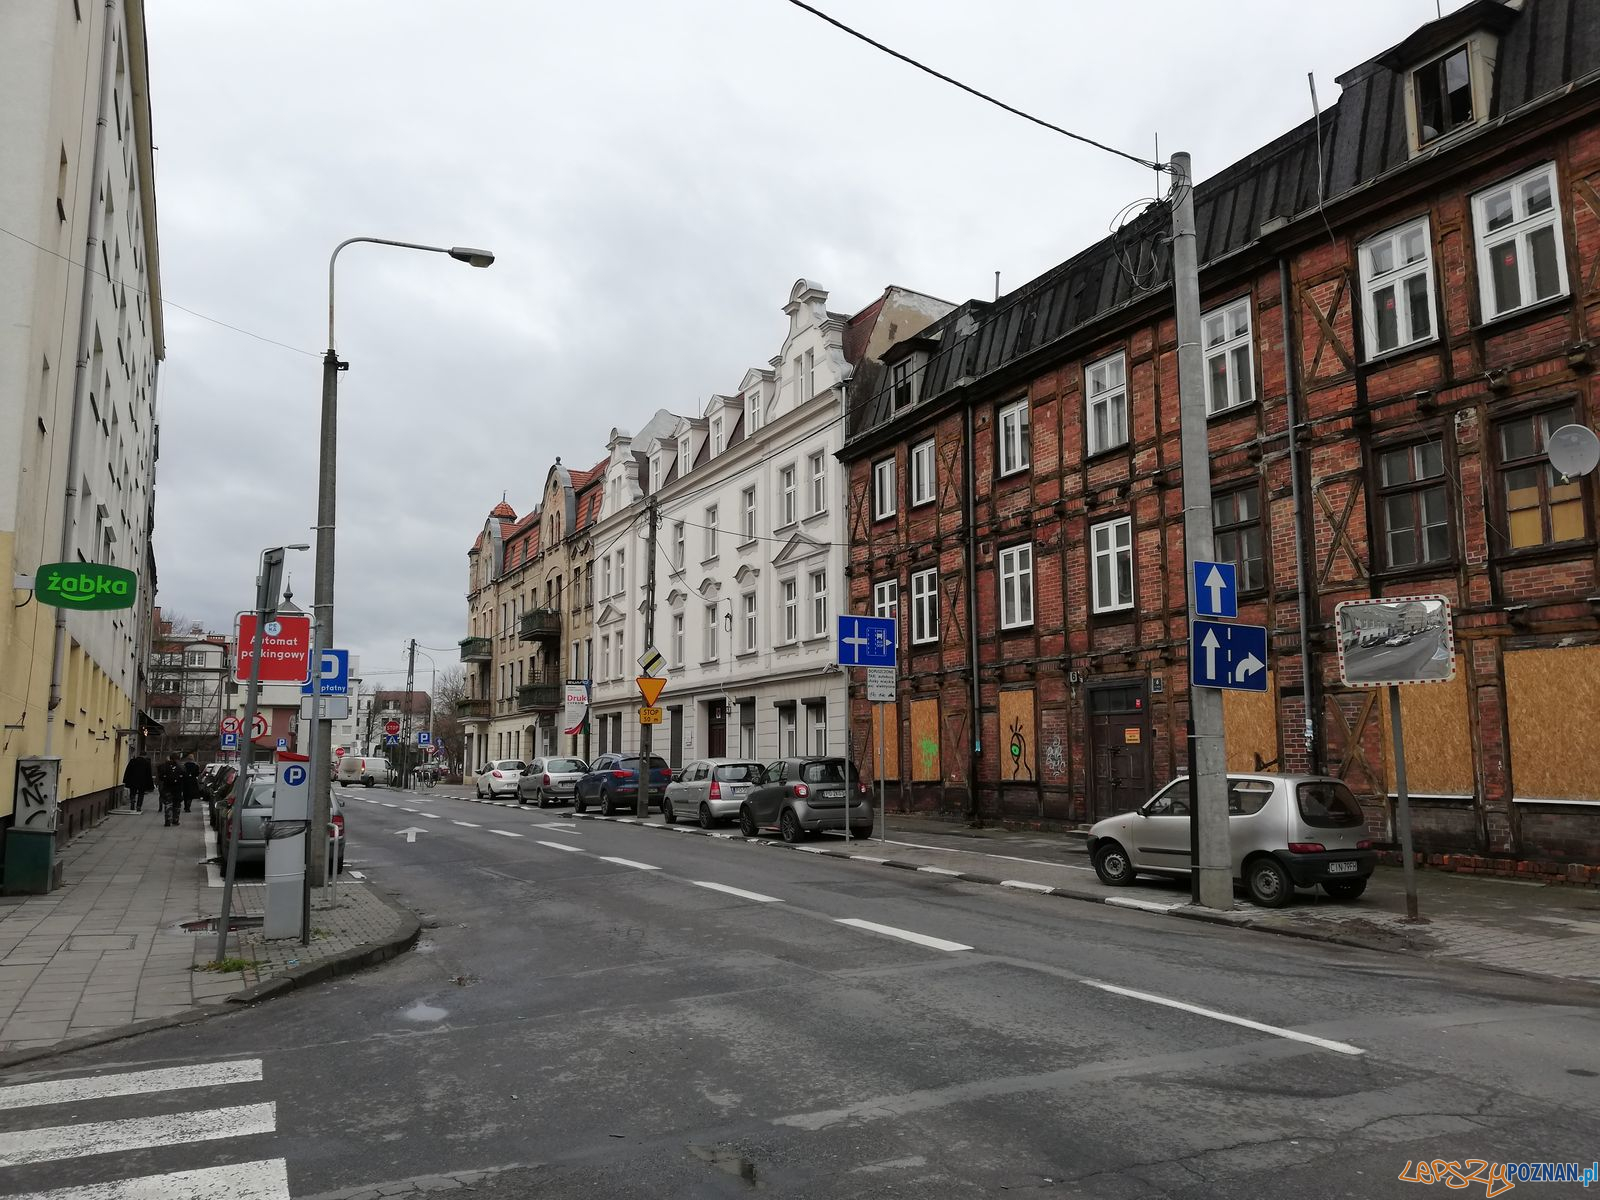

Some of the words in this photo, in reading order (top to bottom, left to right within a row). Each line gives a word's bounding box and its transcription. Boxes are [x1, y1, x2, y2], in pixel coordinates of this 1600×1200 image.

[47, 571, 128, 595] żabka
[241, 648, 305, 661] pakingowy
[321, 684, 346, 692] płatny
[225, 734, 234, 744] P
[420, 733, 428, 743] P
[289, 768, 302, 783] P
